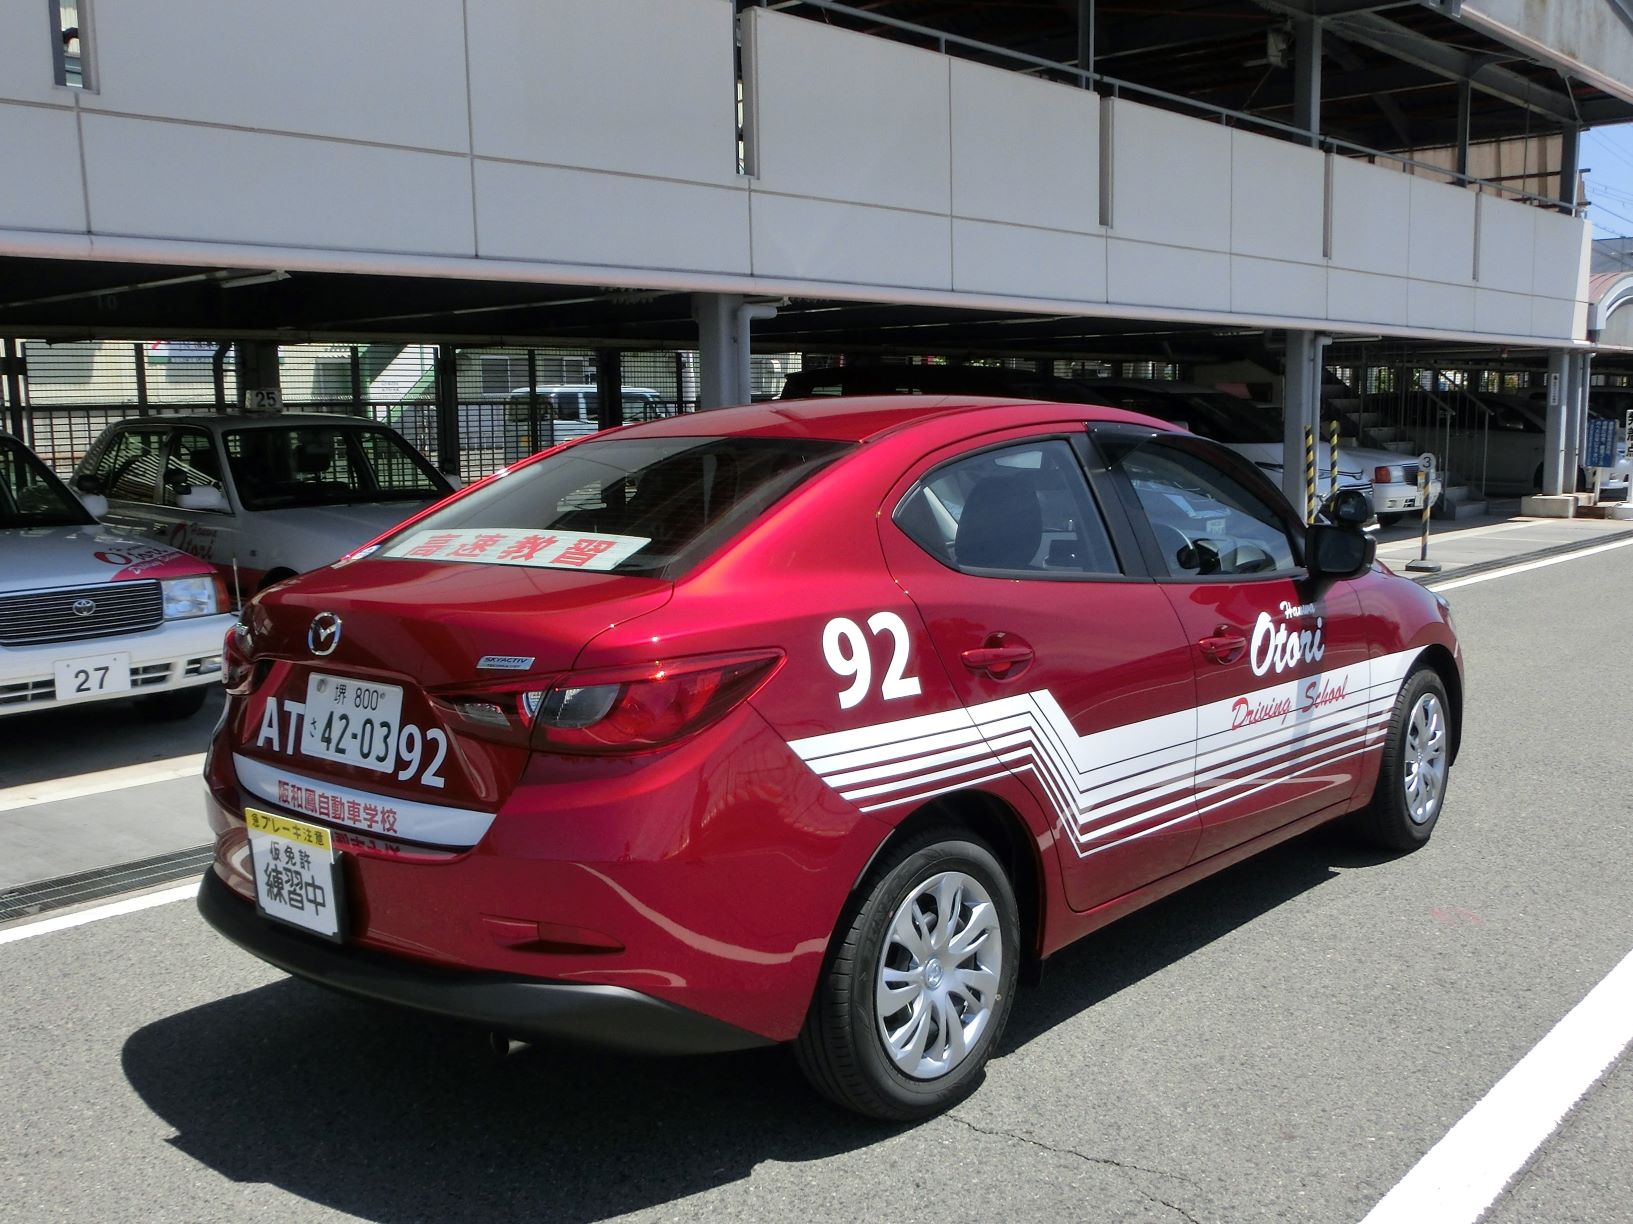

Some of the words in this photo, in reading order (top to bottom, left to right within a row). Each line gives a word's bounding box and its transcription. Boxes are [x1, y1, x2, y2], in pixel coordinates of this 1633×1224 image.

[255, 391, 276, 407] 25
[1422, 456, 1432, 468] 3
[404, 533, 618, 567] 高速教習
[484, 656, 528, 664] SKYACTIV
[822, 611, 922, 710] 92
[1250, 611, 1325, 677] Otori
[74, 666, 110, 693] 27
[333, 683, 347, 706] 堺
[354, 687, 379, 711] 800
[1231, 696, 1292, 731] Driving
[1301, 673, 1349, 714] School
[256, 696, 306, 756] AT
[320, 710, 392, 764] 42-03
[397, 723, 448, 789] 92
[250, 813, 325, 847] 急ブレーキ注意
[264, 862, 327, 917] 練習中
